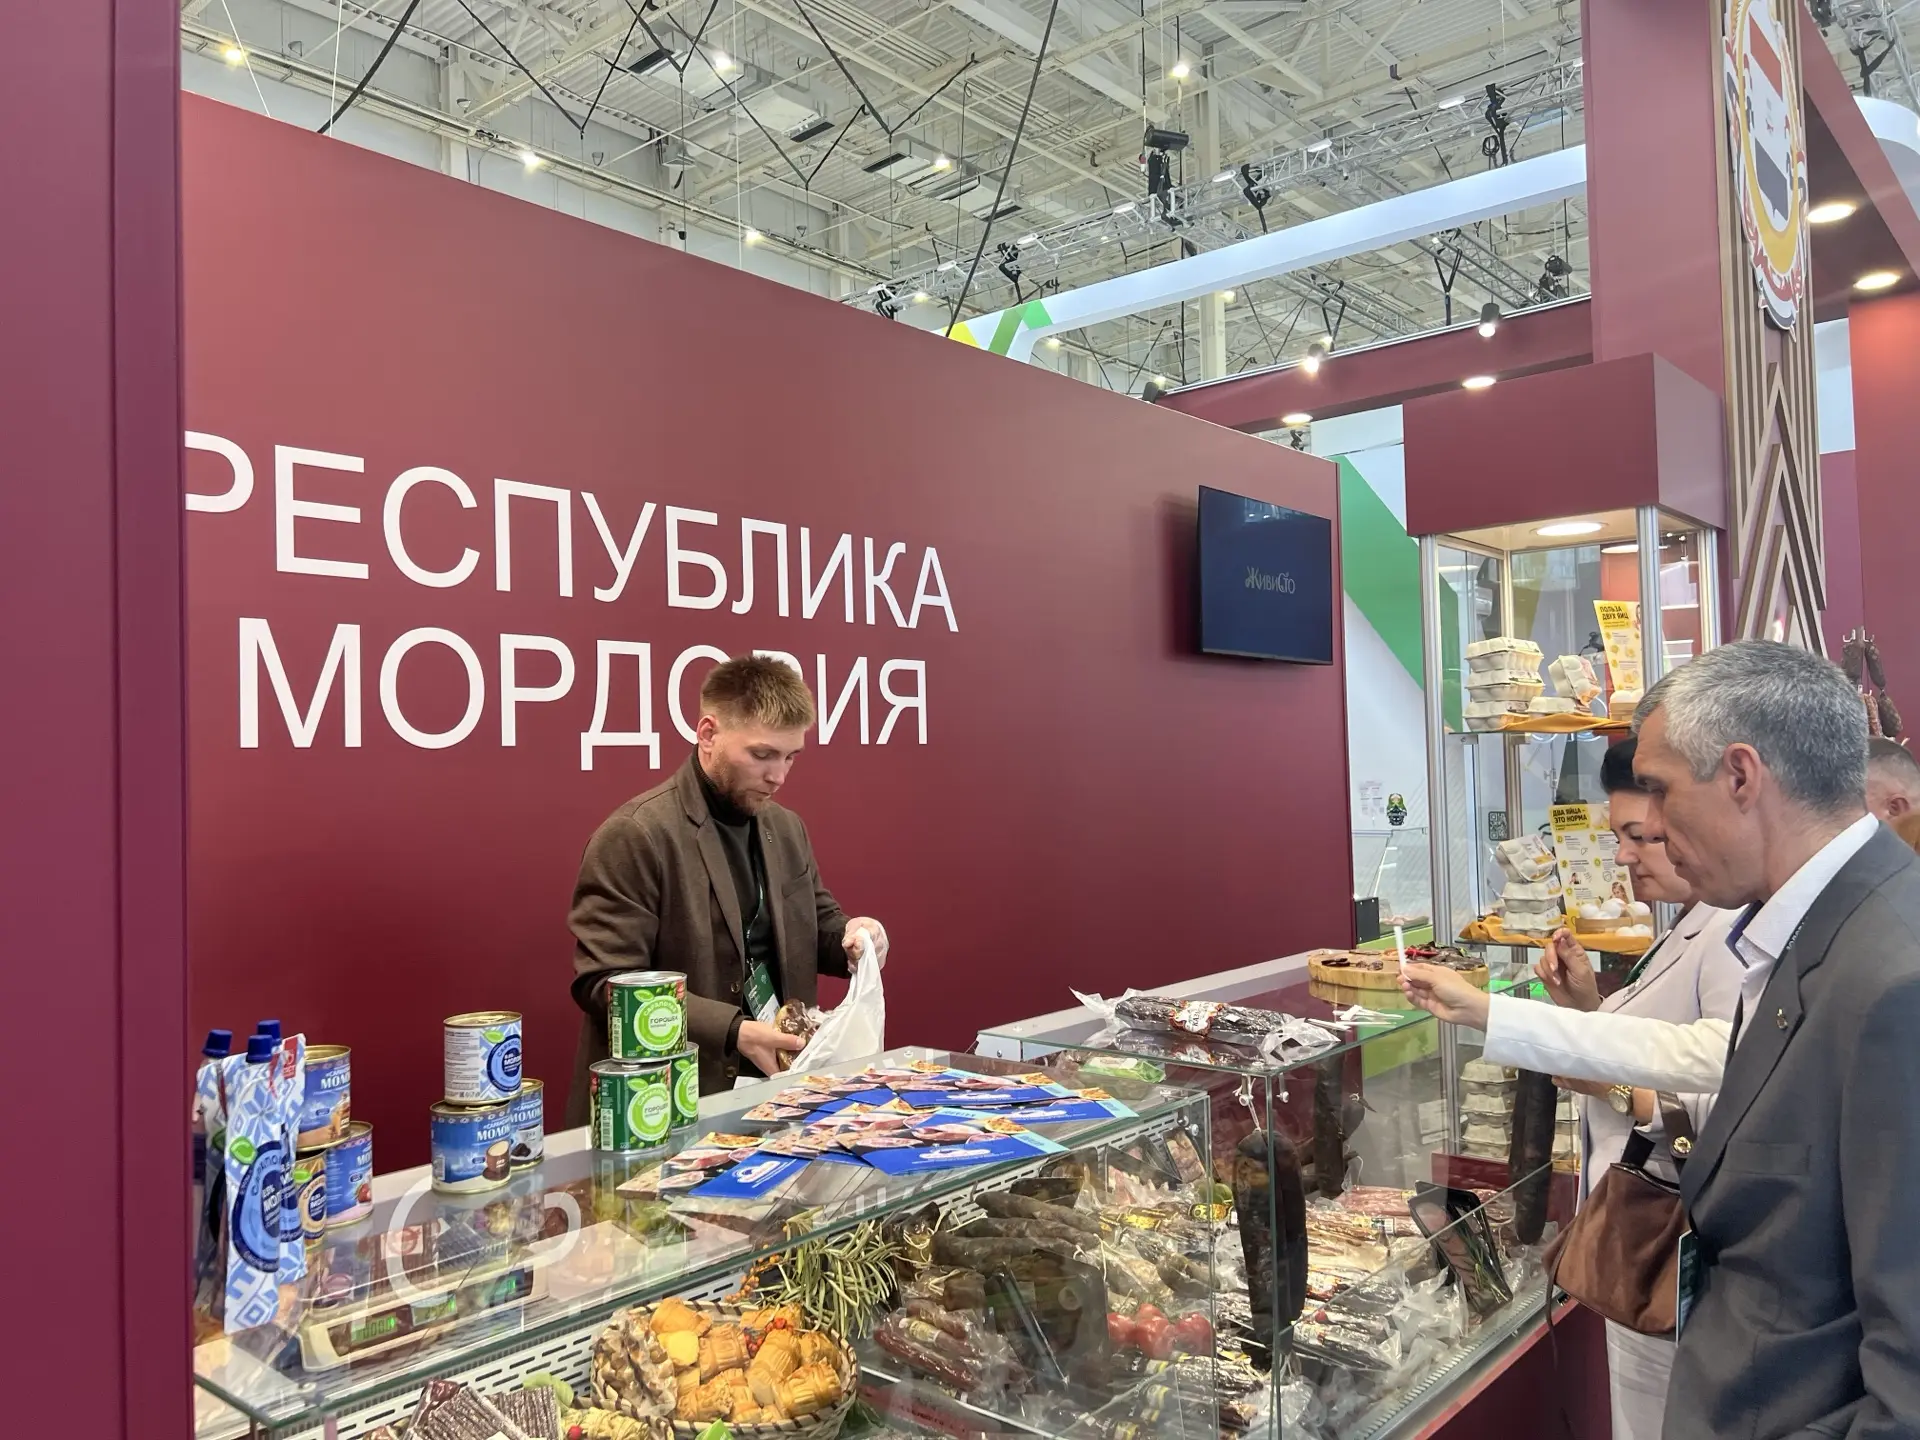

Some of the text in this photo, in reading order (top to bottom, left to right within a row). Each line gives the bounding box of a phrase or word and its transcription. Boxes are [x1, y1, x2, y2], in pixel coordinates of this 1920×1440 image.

[239, 617, 928, 771] МОРДОИЯ
[1552, 808, 1565, 817] ДВА
[1554, 814, 1588, 824] ЭТО НОРМА
